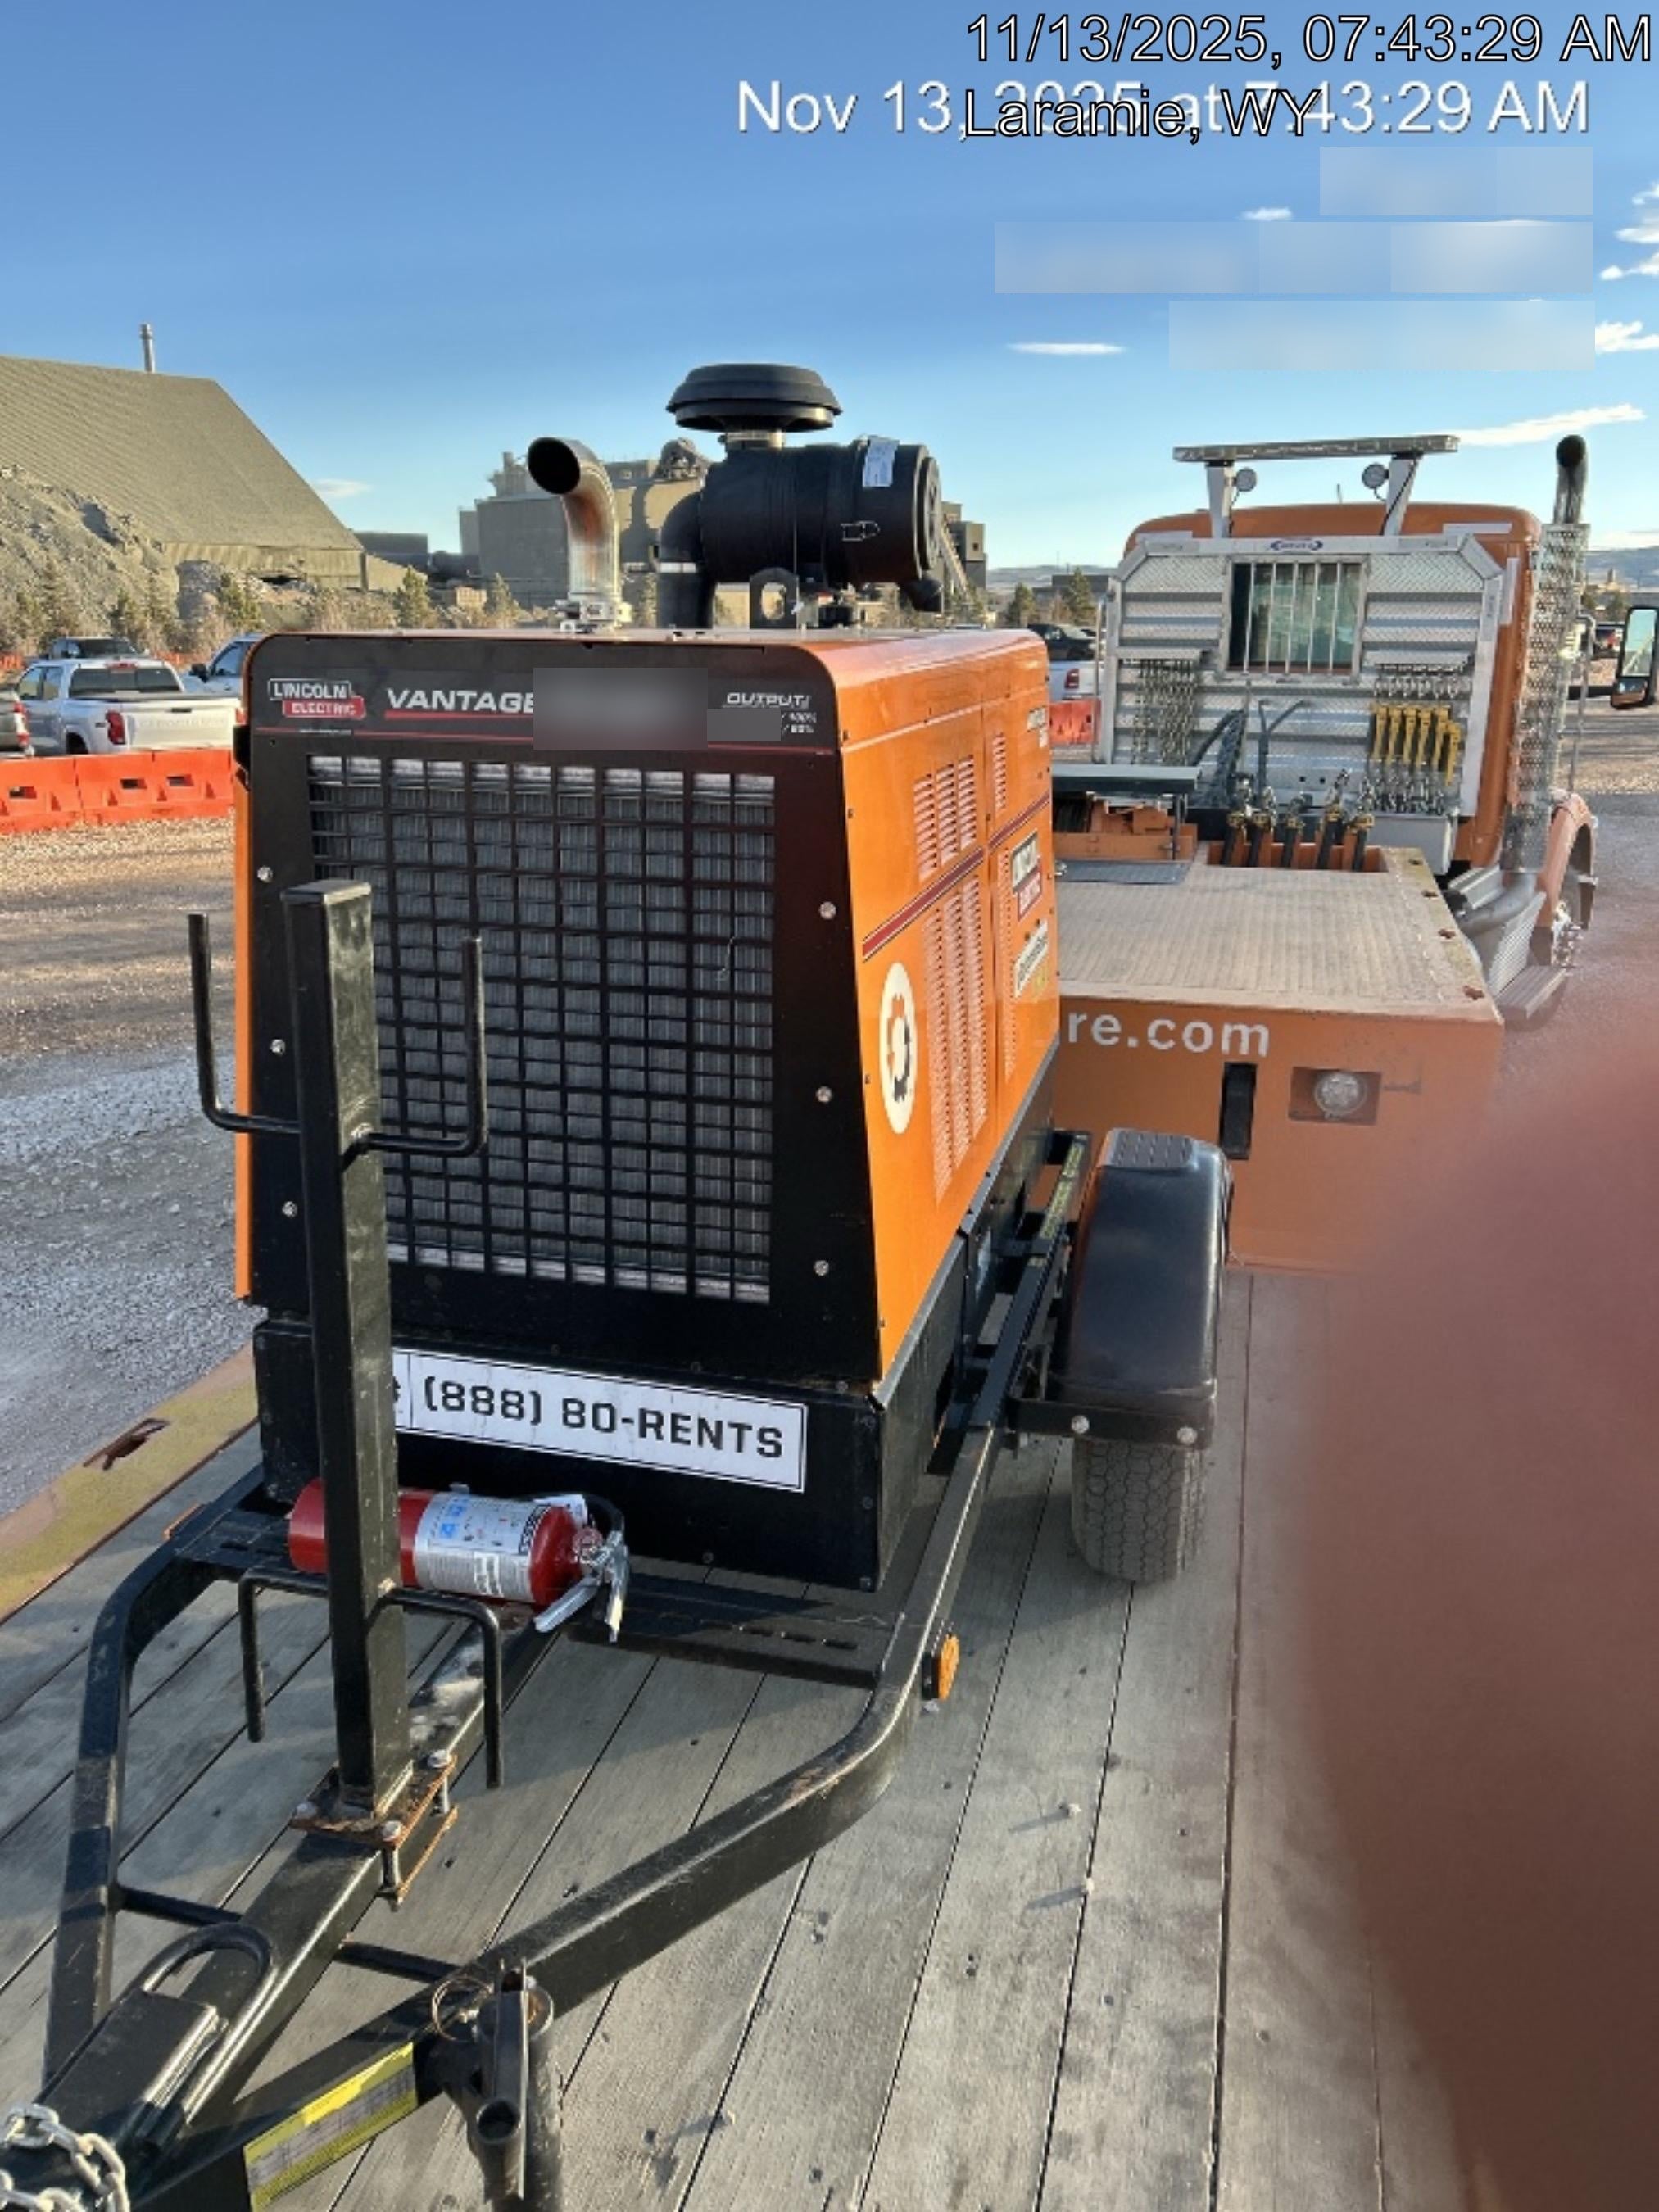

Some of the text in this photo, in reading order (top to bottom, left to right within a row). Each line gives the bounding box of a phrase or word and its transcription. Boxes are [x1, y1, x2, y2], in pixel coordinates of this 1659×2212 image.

[274, 682, 347, 699] LINCOLN
[726, 692, 806, 707] OUTPUT
[1067, 1012, 1269, 1057] re.com
[424, 1376, 542, 1426] (888)
[562, 1398, 783, 1458] 80-RENTS
